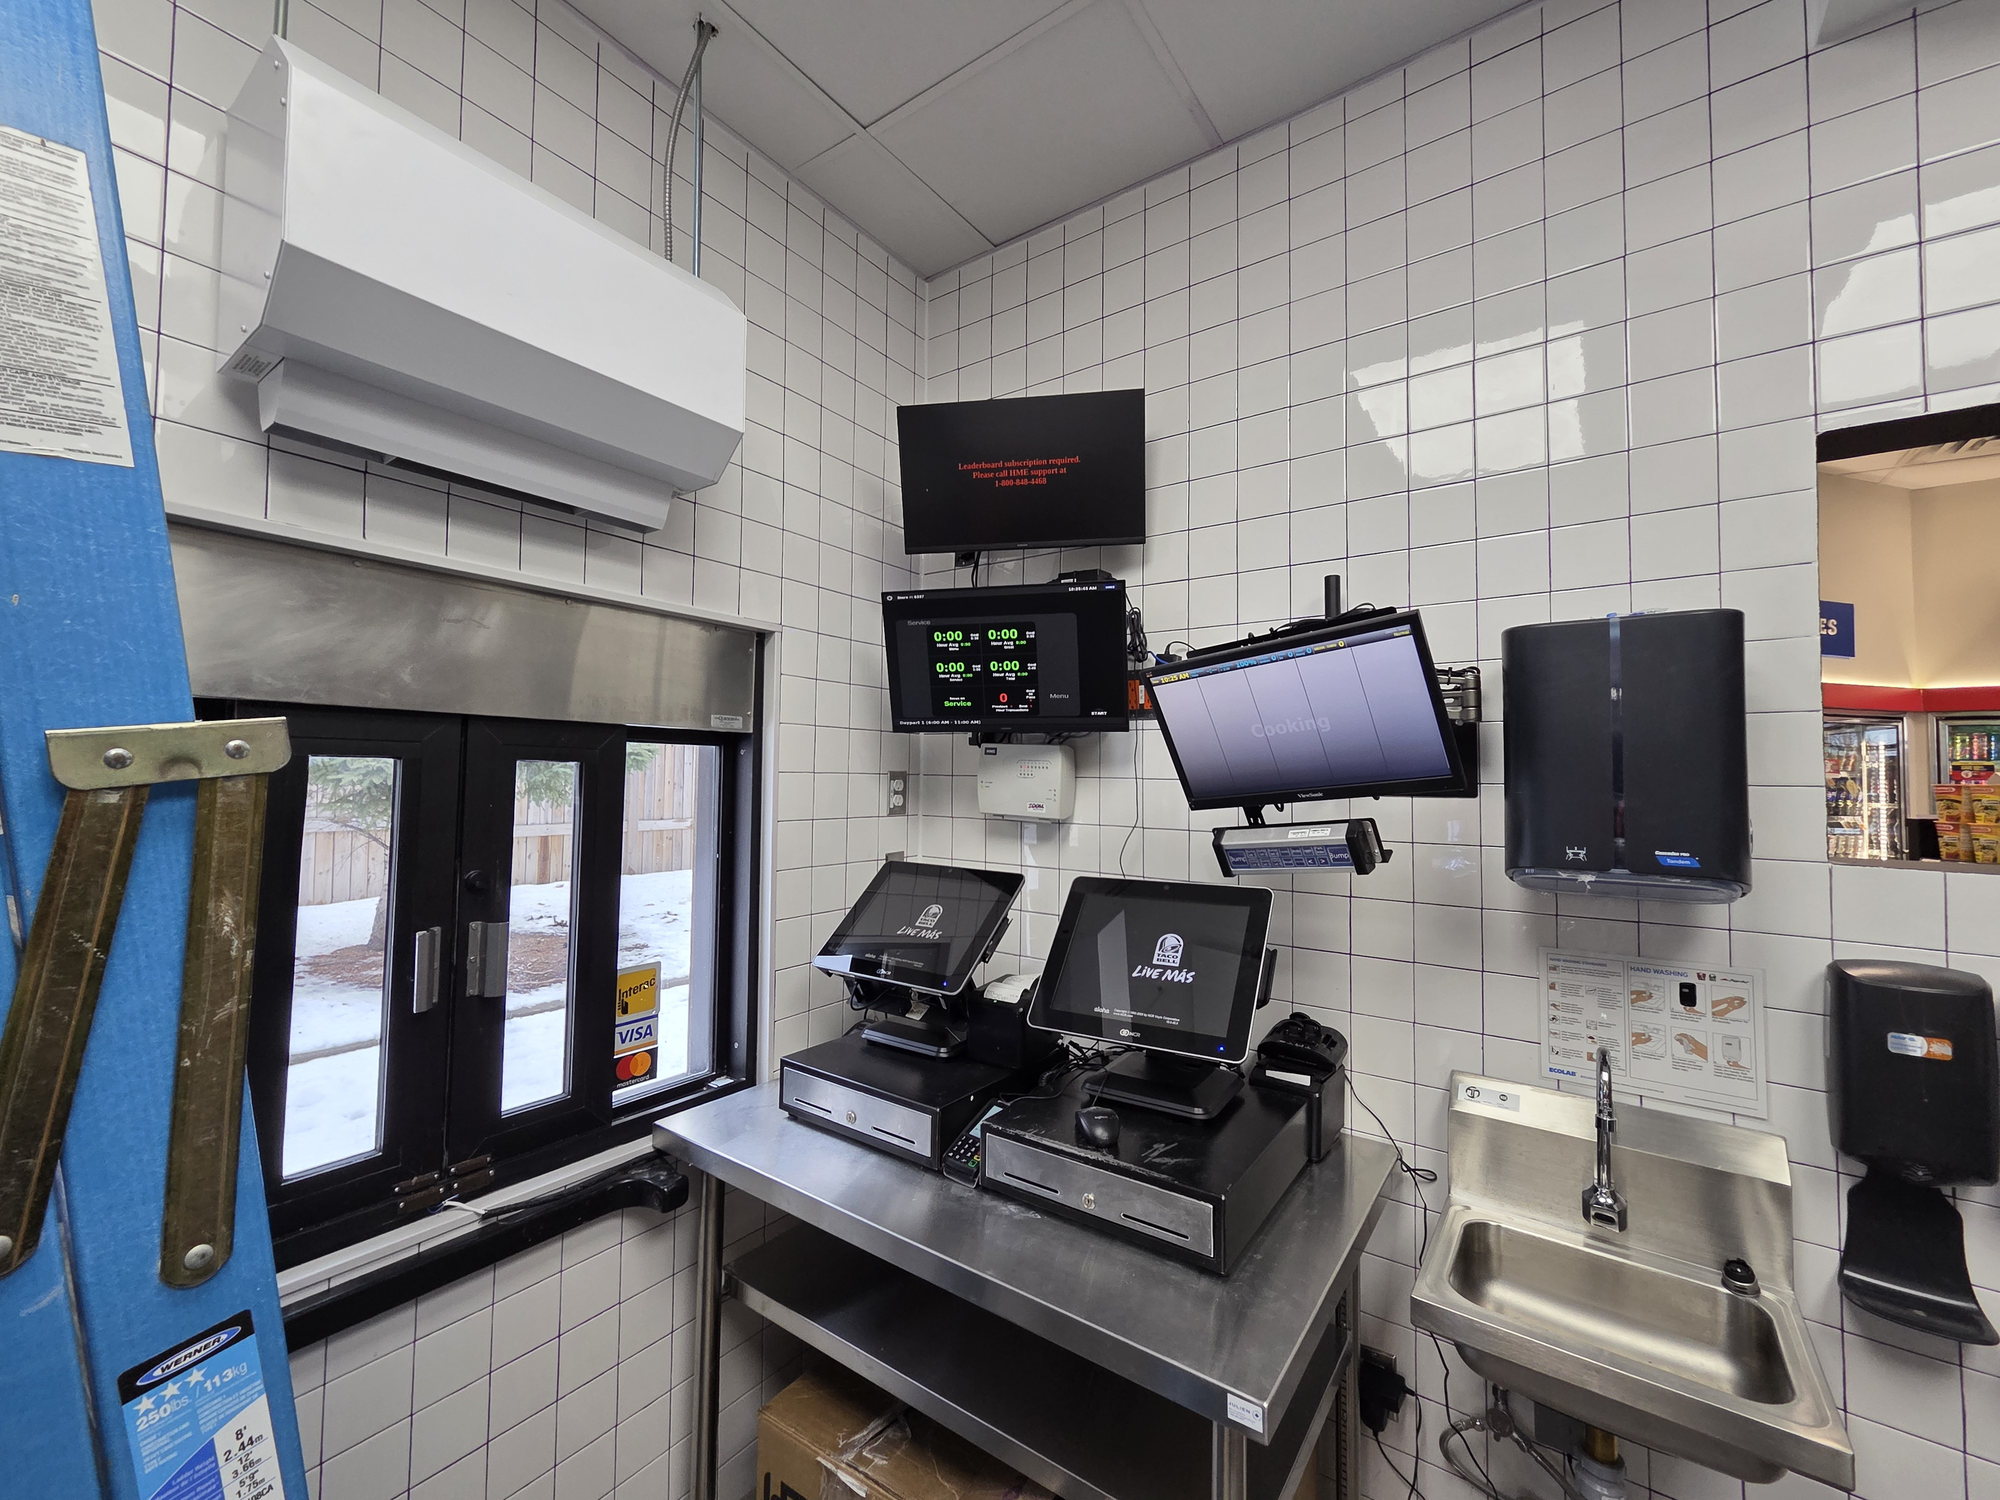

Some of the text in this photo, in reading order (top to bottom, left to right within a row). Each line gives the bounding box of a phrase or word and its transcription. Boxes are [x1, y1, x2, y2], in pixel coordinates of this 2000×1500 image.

[958, 456, 1080, 470] Leaderboard subscription required.
[1030, 467, 1058, 476] support
[934, 631, 963, 642] 0:00
[988, 629, 1018, 640] 0:00
[936, 662, 964, 673] 0:00
[990, 661, 1019, 671] 0:00
[1000, 693, 1008, 703] 0
[1251, 715, 1331, 738] Cooking
[1162, 969, 1195, 983] MÁS
[1653, 968, 1688, 978] WASHING
[619, 977, 656, 1001] Interac
[616, 1024, 653, 1044] VISA
[1549, 1068, 1576, 1076] ECOLAB
[617, 1074, 649, 1088] mastercard
[159, 1336, 222, 1374] WERNER
[203, 1362, 248, 1393] 113kg
[136, 1396, 189, 1432] 250lbs
[234, 1426, 247, 1441] 8'
[223, 1434, 263, 1462] 2.44m
[238, 1451, 253, 1465] 12'
[232, 1458, 262, 1479] 3.66m
[236, 1478, 266, 1498] 1.75m
